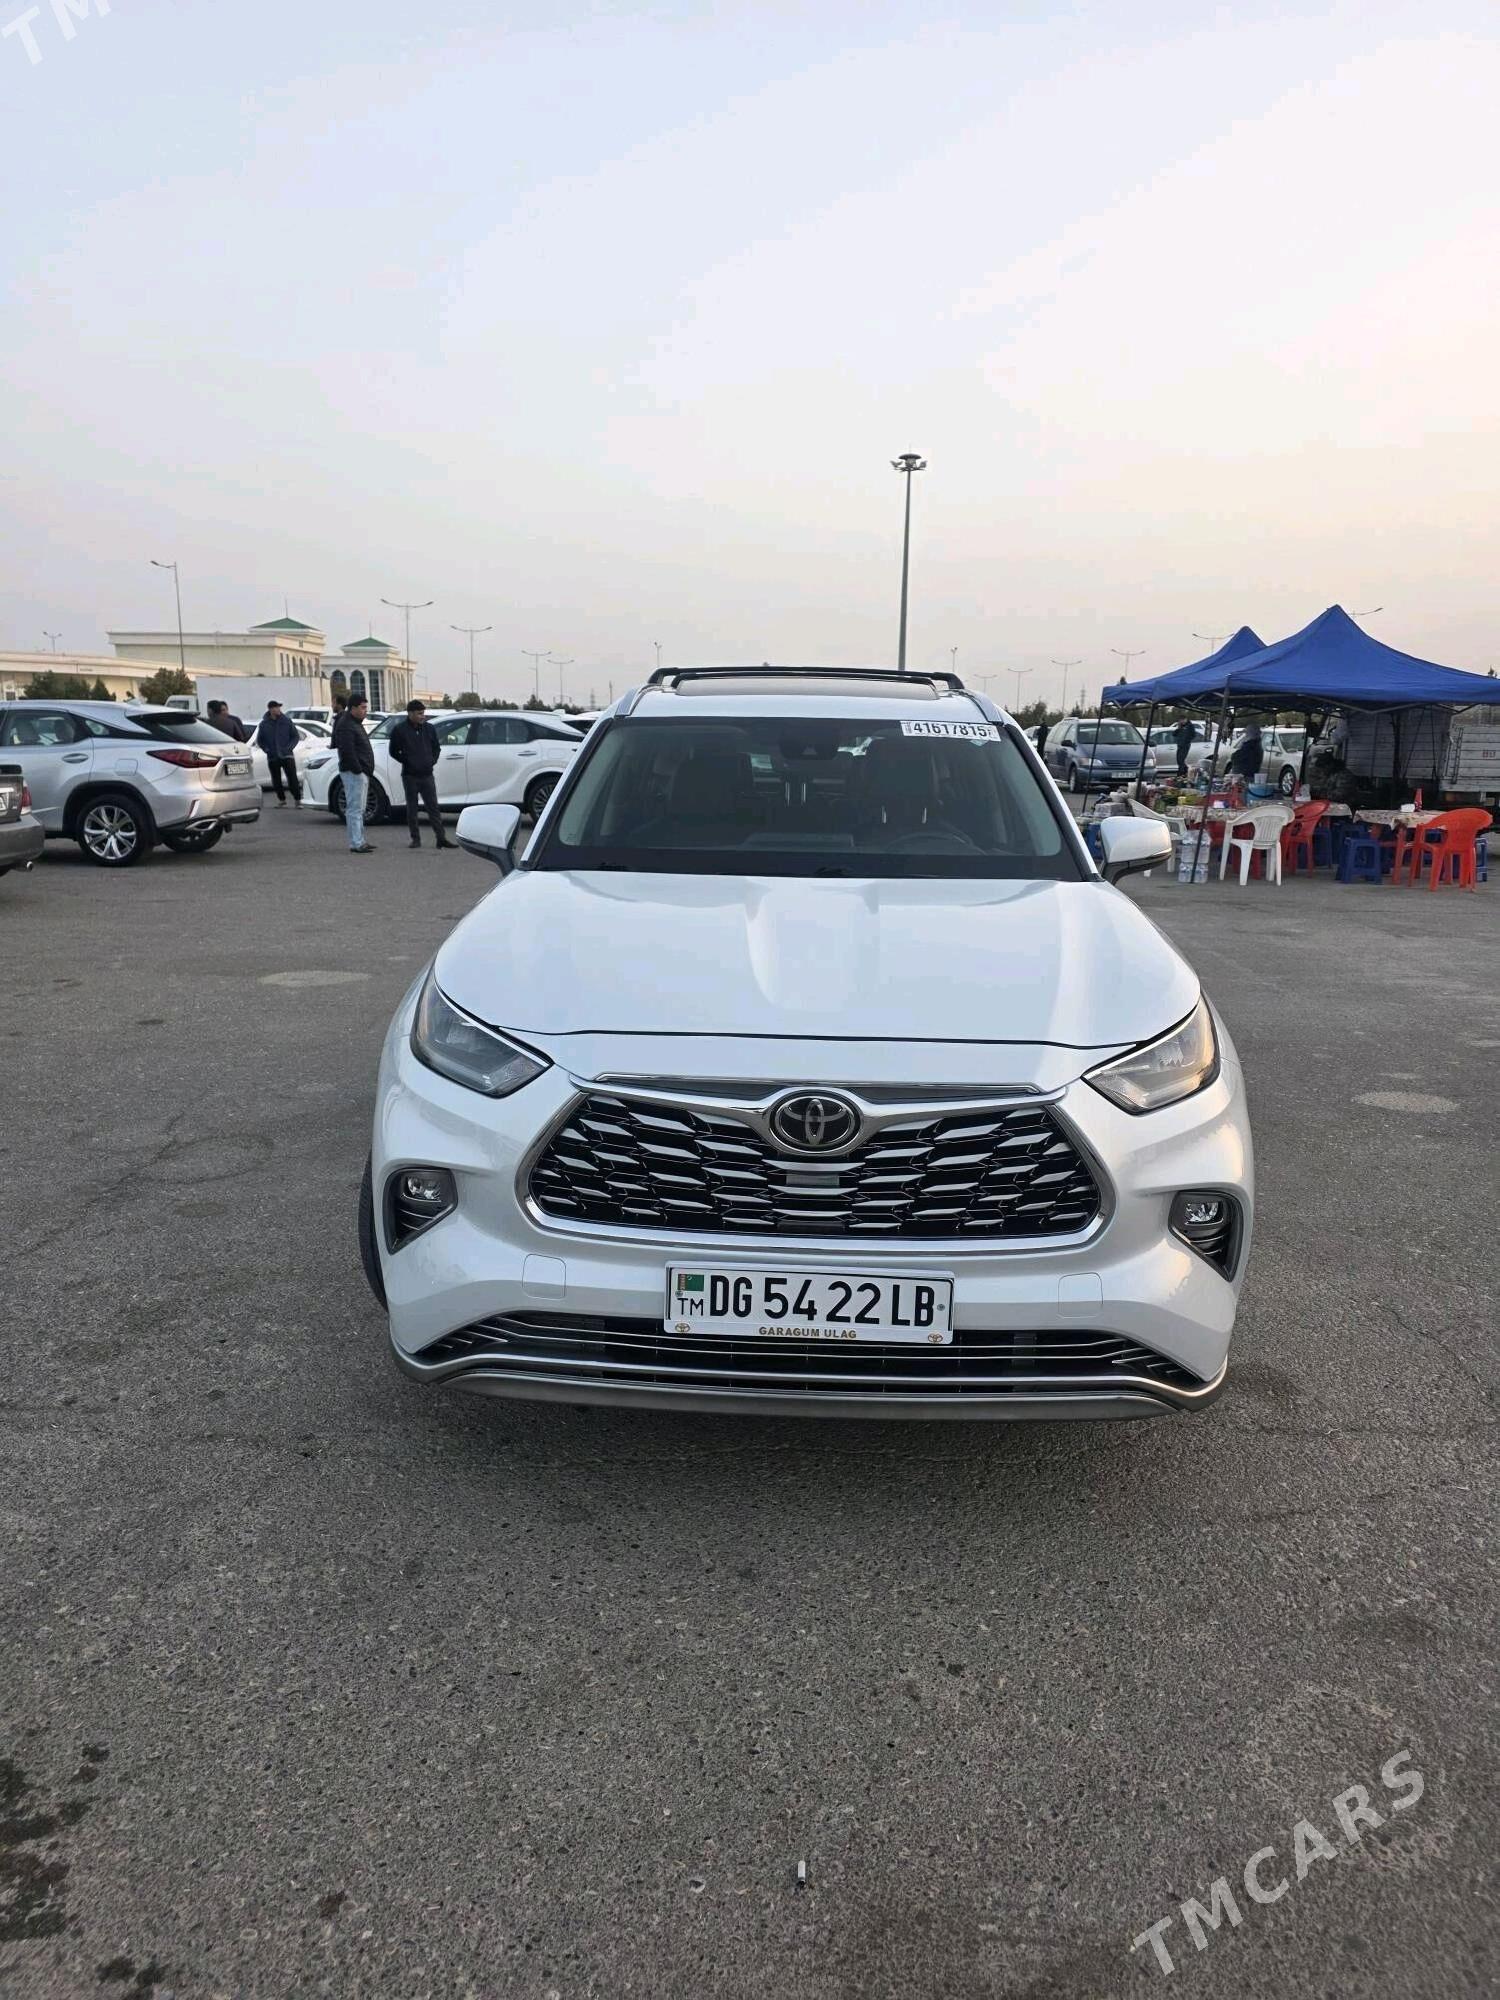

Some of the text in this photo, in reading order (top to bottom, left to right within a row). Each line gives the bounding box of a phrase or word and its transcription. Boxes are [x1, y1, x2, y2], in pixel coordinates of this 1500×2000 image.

[677, 1297, 704, 1316] TM
[758, 1326, 857, 1339] GARAGUM ULAG
